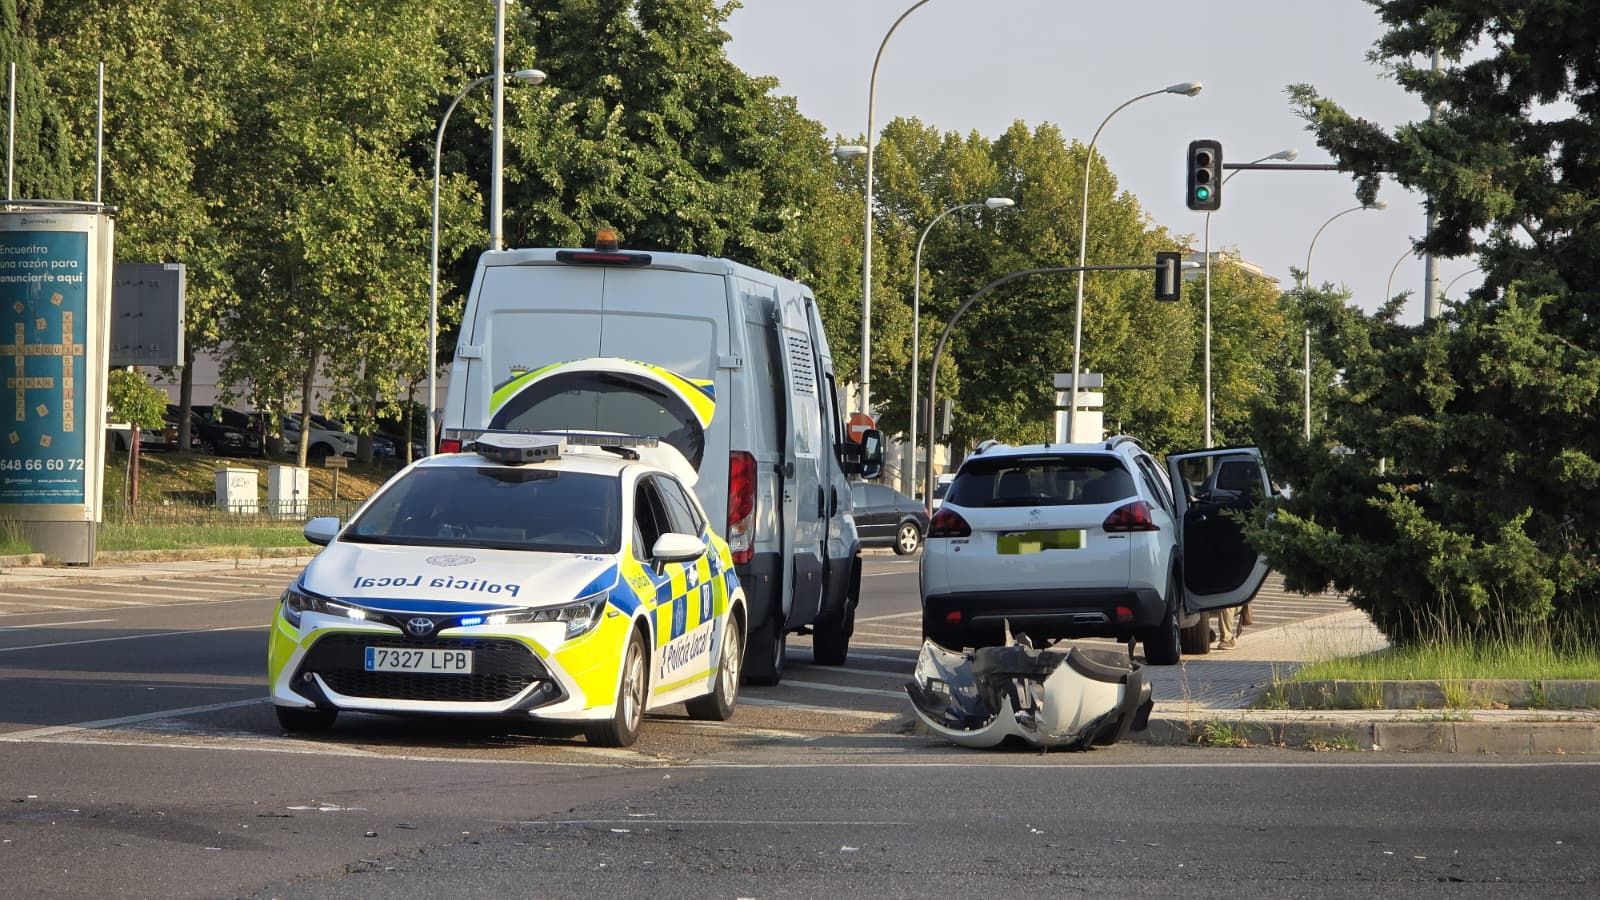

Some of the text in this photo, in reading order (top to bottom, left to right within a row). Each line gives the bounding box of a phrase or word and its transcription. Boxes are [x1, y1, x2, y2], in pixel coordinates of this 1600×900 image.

[0, 245, 48, 255] Encuentra
[18, 258, 48, 269] razón
[51, 260, 78, 270] para
[0, 272, 83, 285] anunciarte aquí
[0, 459, 84, 471] 648 66 60 72
[378, 650, 466, 670] 7327 LPB
